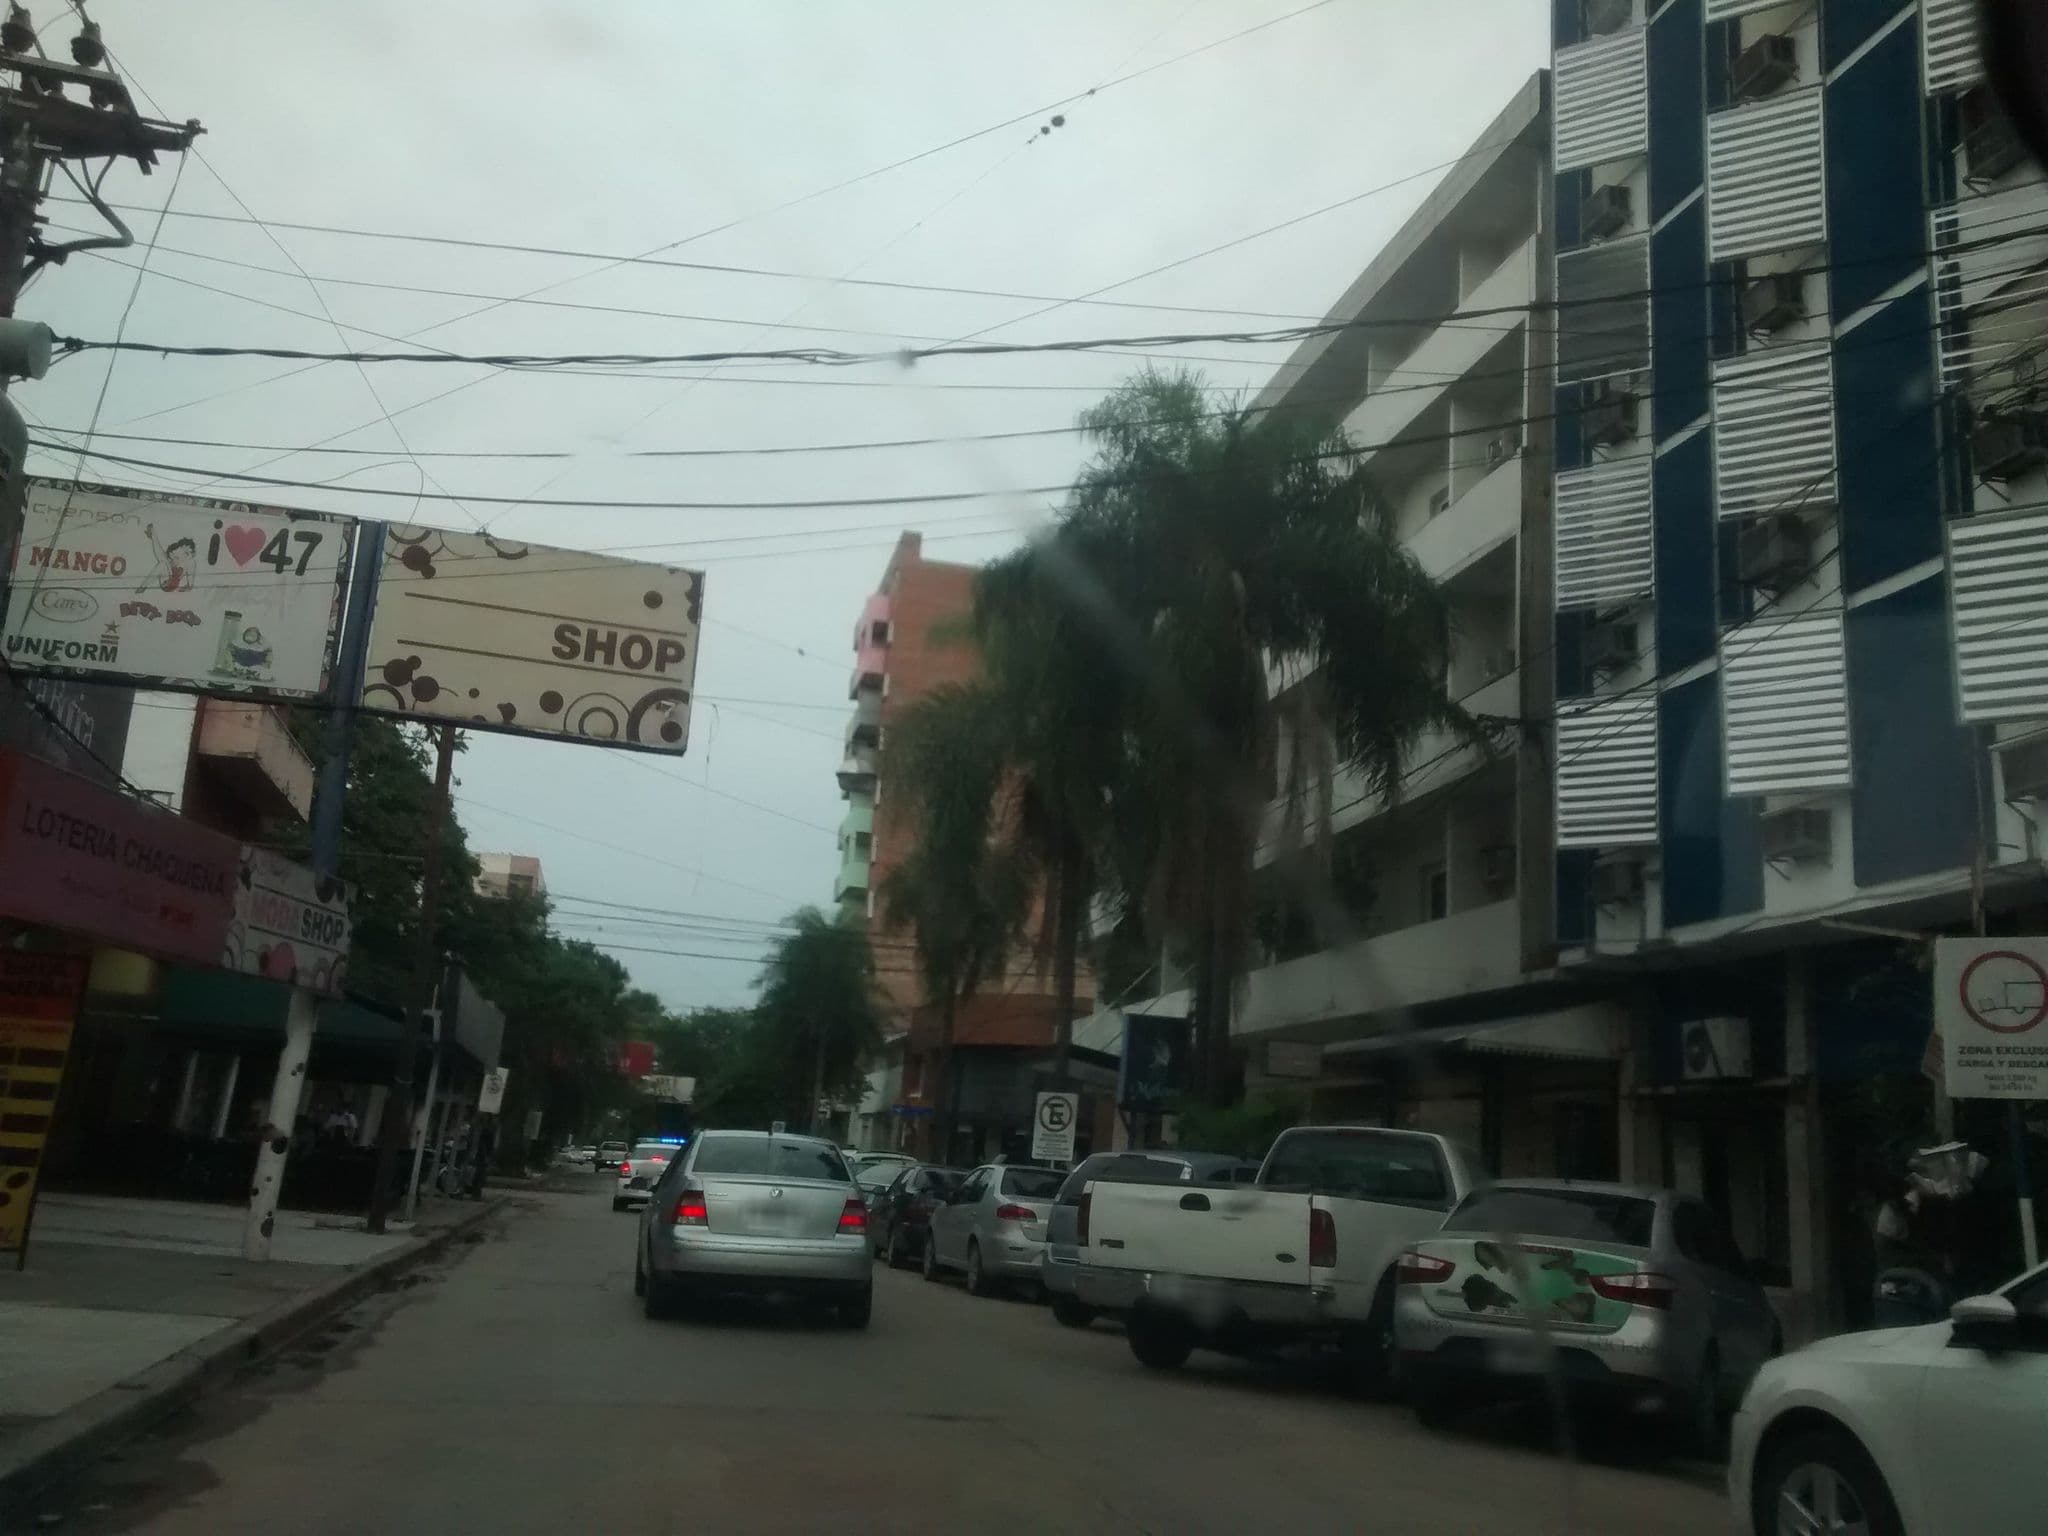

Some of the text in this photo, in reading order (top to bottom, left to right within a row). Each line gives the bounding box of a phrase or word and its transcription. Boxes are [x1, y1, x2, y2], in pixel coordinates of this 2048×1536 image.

[29, 546, 127, 576] MANGO
[259, 528, 323, 576] 47
[6, 634, 119, 662] UNIFORM
[551, 624, 686, 672] SHOP
[301, 907, 345, 945] SHOP
[1959, 1046, 1993, 1056] ZONA
